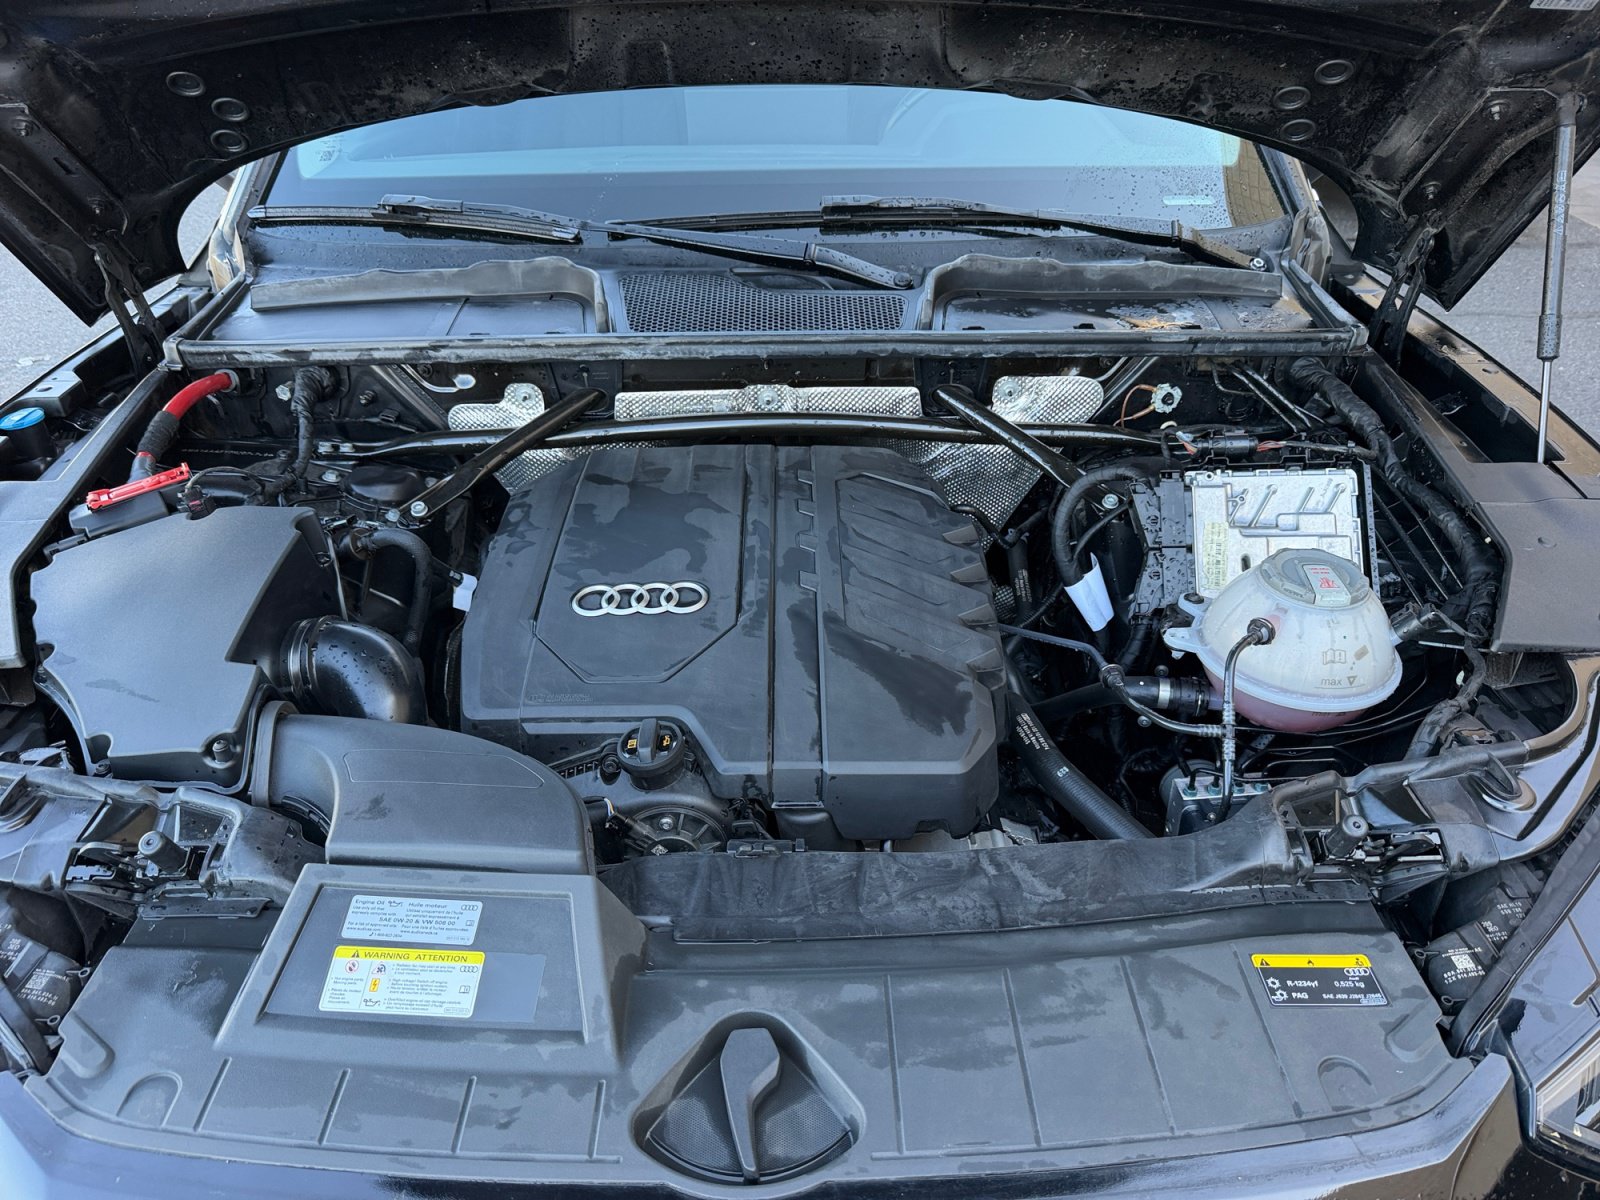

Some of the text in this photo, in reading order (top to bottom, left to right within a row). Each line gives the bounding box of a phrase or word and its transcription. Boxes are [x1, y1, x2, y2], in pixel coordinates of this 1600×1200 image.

[364, 951, 468, 962] WARNING ATTENTION
[1355, 980, 1366, 988] kg
